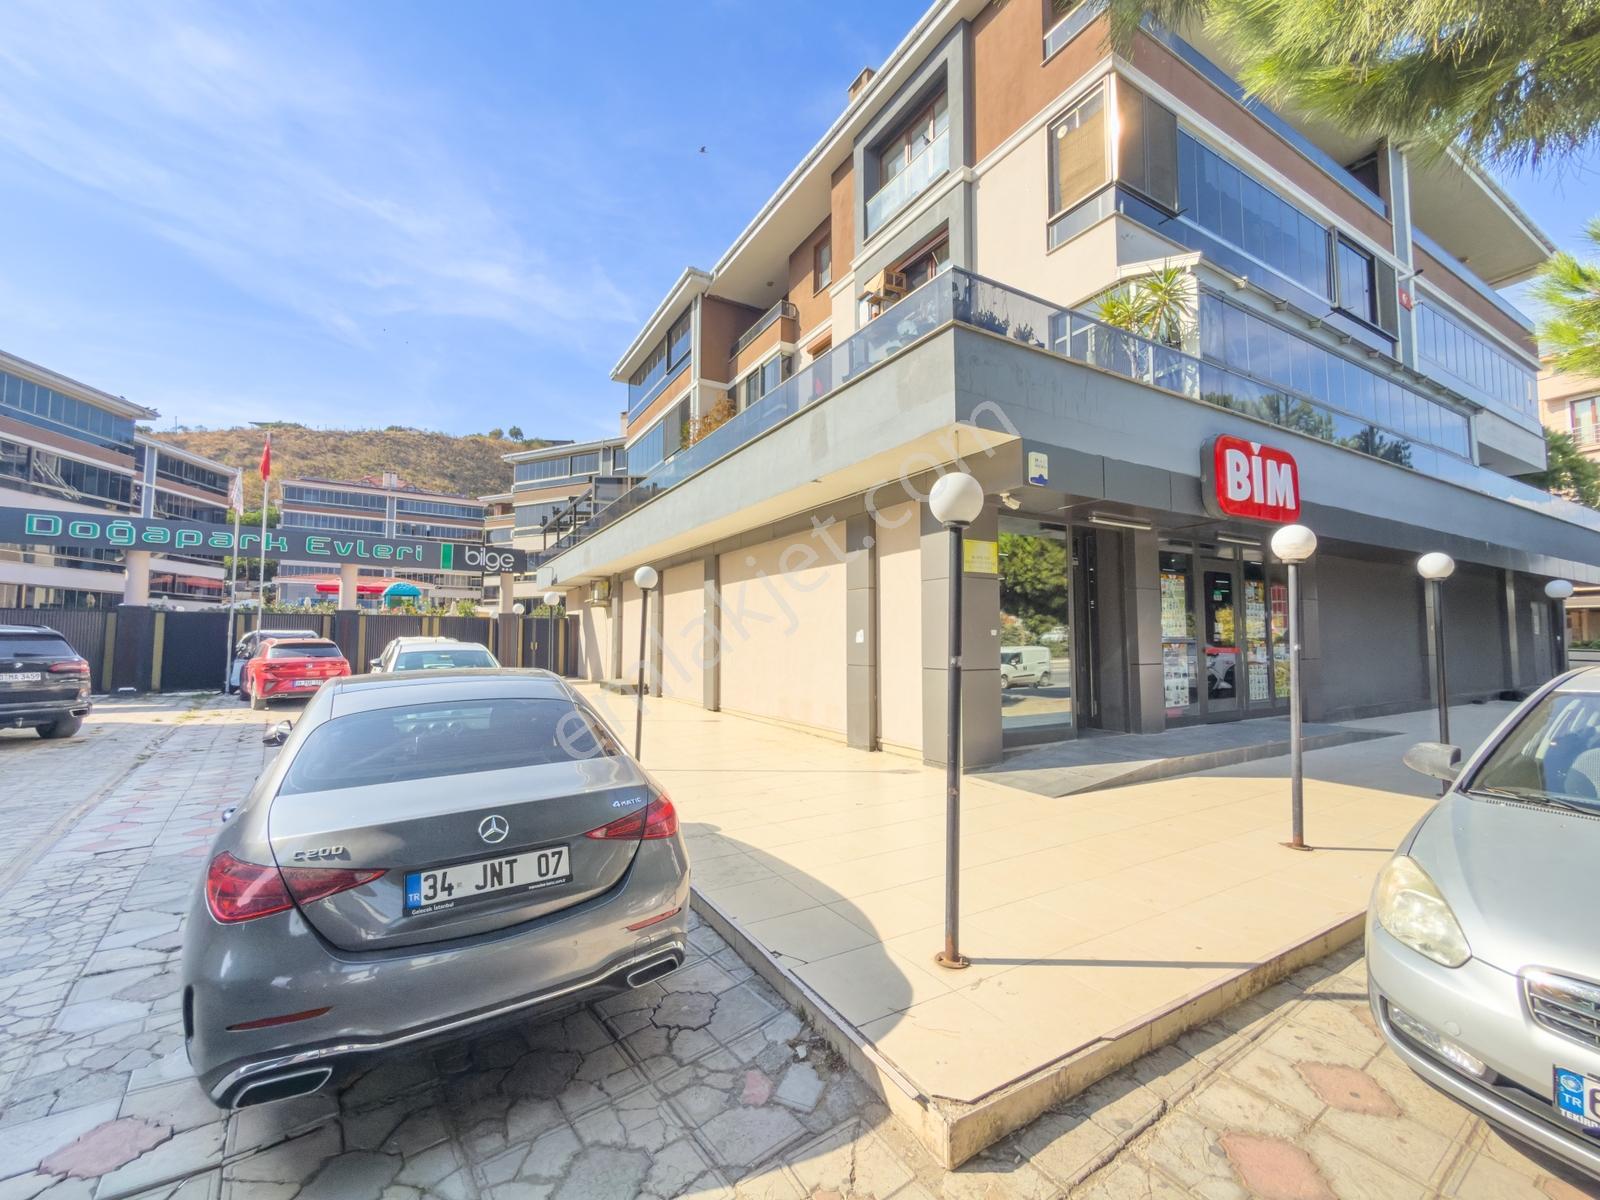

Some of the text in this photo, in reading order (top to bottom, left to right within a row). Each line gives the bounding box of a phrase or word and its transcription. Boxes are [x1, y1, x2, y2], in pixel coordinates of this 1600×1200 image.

[25, 513, 423, 562] Doğapark Evleri
[465, 546, 514, 571] bilge
[408, 892, 420, 902] TR
[423, 871, 454, 901] 34
[475, 858, 518, 891] JNT
[537, 850, 563, 877] 07
[1562, 1092, 1582, 1108] TR
